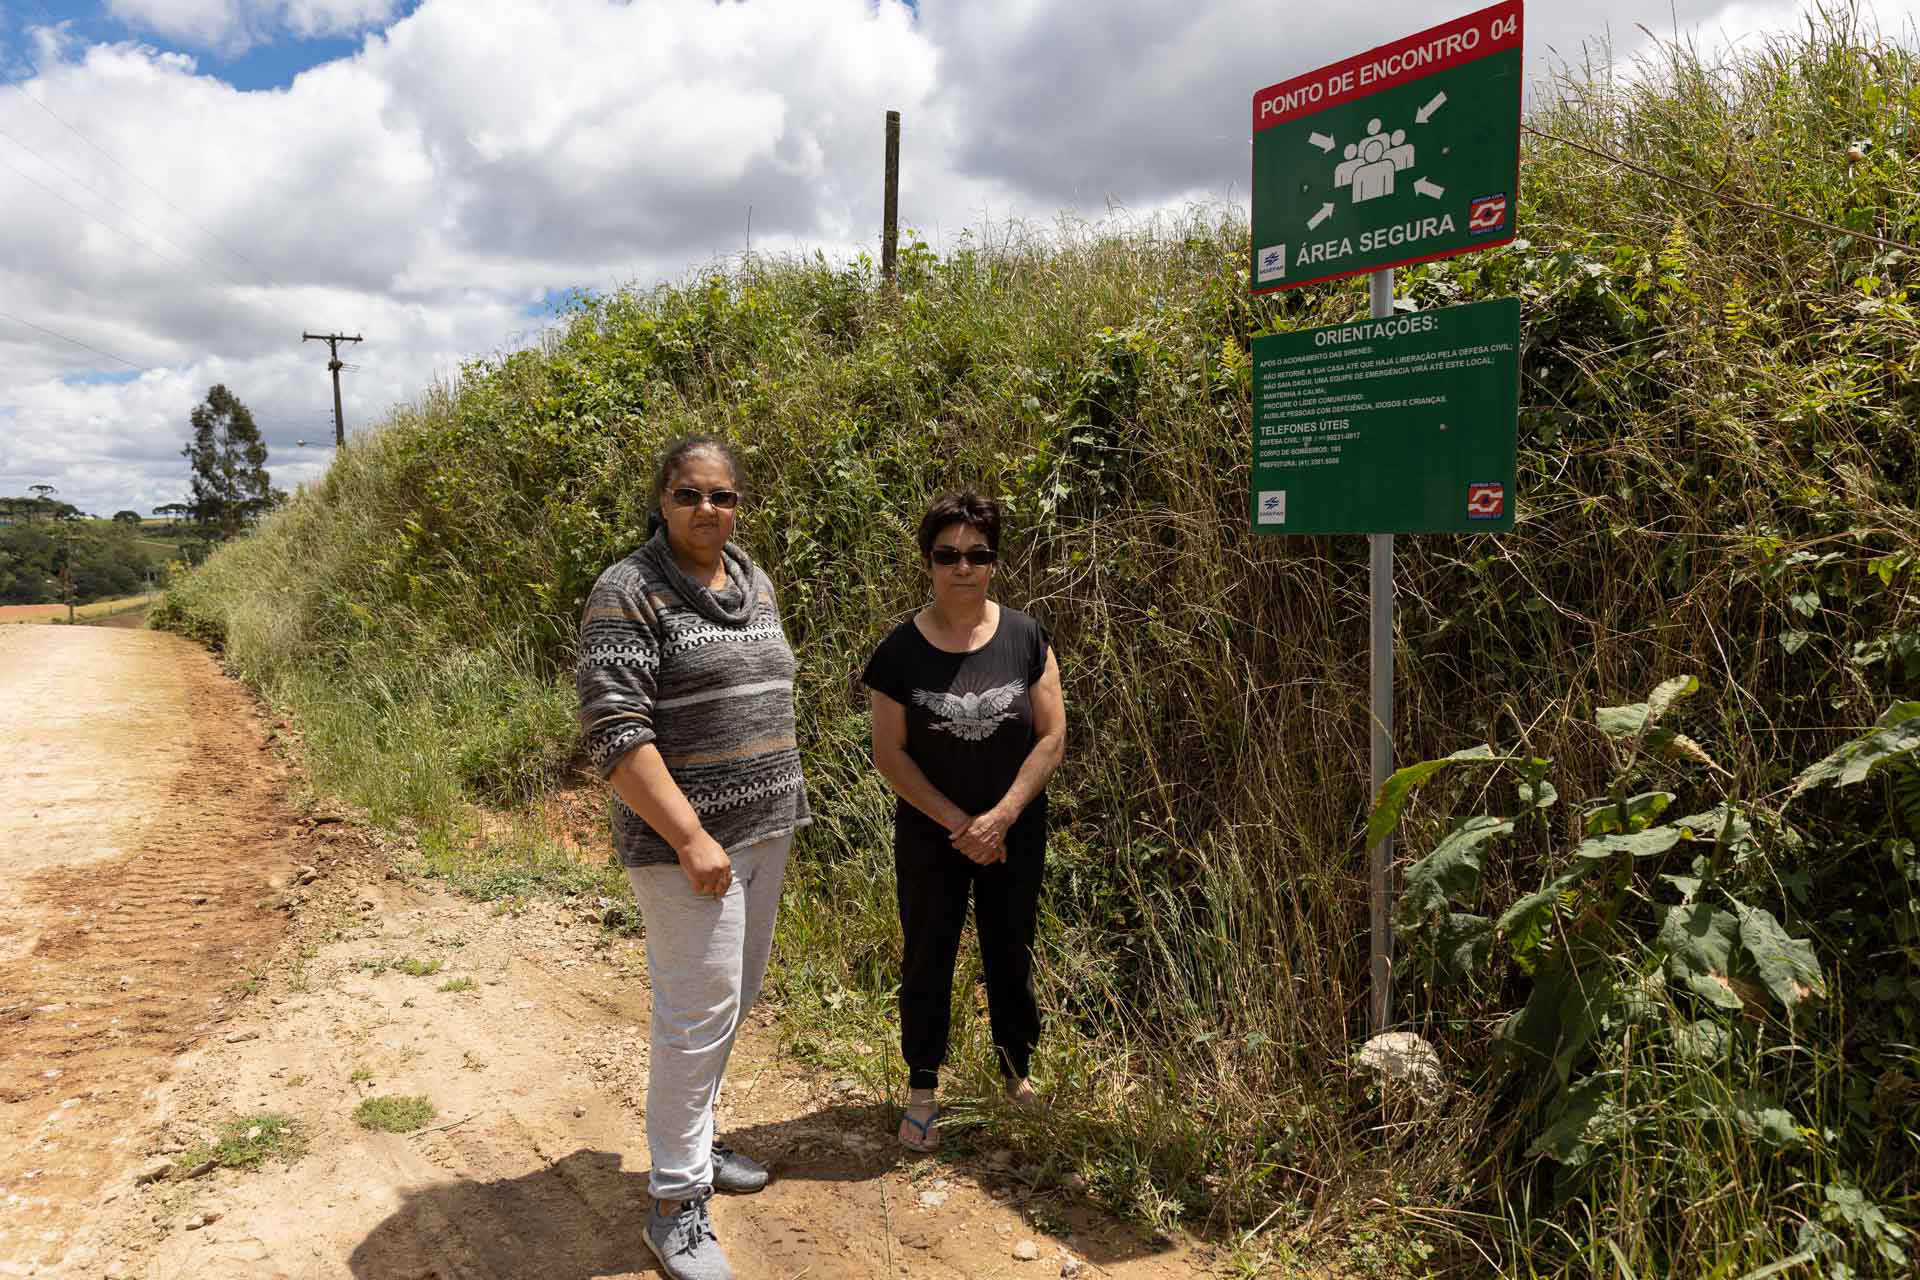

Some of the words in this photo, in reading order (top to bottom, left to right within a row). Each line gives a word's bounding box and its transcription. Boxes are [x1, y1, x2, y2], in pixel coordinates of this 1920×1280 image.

[1261, 83, 1323, 119] PONTO
[1328, 71, 1354, 97] DE
[1360, 27, 1479, 86] ENCONTRO
[1490, 14, 1517, 41] 04
[1296, 235, 1353, 267] ÁREA
[1359, 213, 1455, 252] SEGURA
[1314, 315, 1438, 346] ORIENTAÇÕES:
[1263, 371, 1277, 380] NÃO
[1327, 365, 1345, 373] CASA
[1360, 360, 1375, 369] QUE
[1395, 352, 1436, 365] LIBERAÇÃO
[1438, 350, 1458, 360] PELA
[1459, 346, 1489, 356] DEFESA
[1329, 350, 1342, 359] DAS
[1263, 380, 1277, 390] NÃO
[1314, 377, 1329, 386] UMA
[1330, 374, 1353, 383] EQUIPE
[1354, 372, 1364, 381] DE
[1365, 366, 1410, 379] EMERGÊNCIA
[1411, 363, 1428, 373] VIRÁ
[1430, 361, 1444, 371] ATÉ
[1445, 360, 1465, 370] ESTE
[1287, 408, 1316, 418] PESSOAS
[1316, 406, 1331, 416] COM
[1375, 400, 1401, 409] IDOSOS
[1260, 420, 1317, 436] TELEFONES
[1319, 418, 1350, 432] ÚTEIS
[1260, 438, 1283, 447] DEFESA
[1281, 448, 1290, 456] DE
